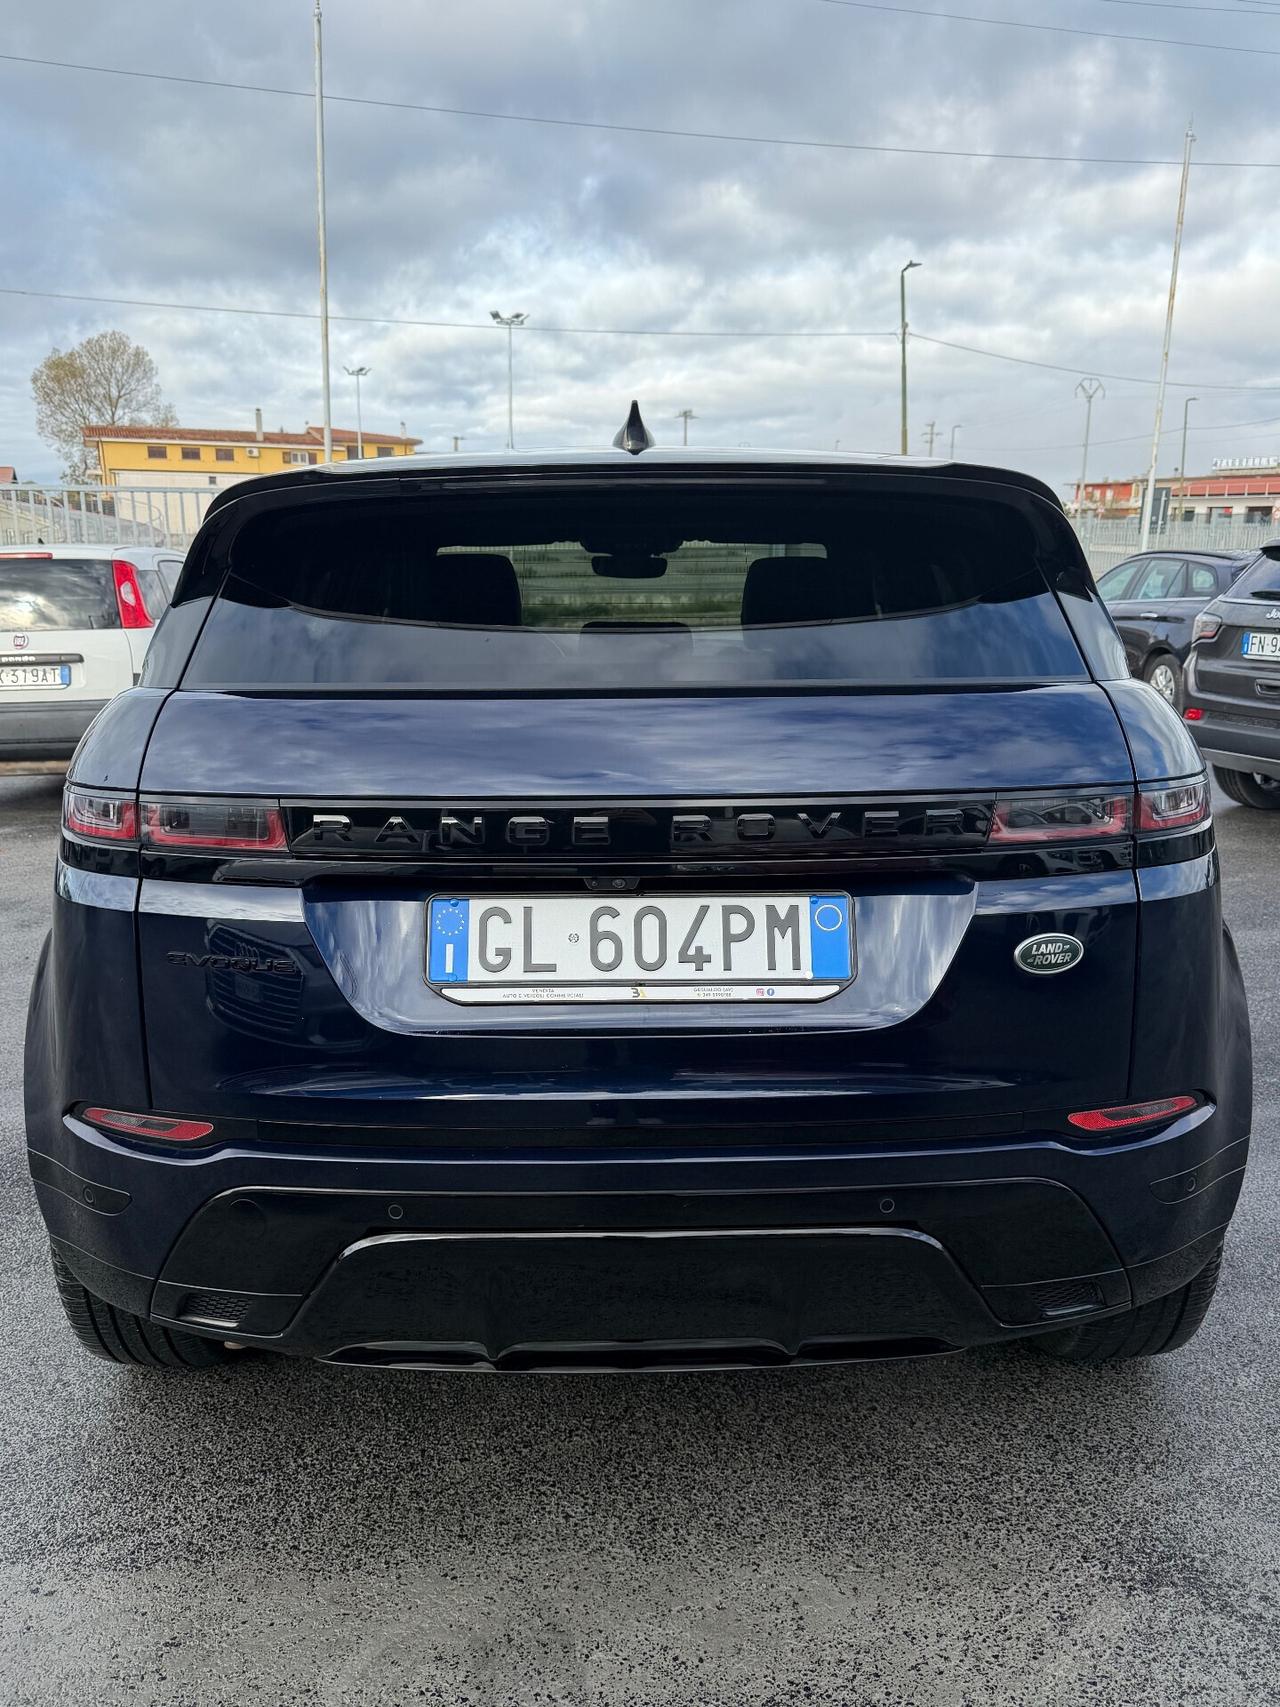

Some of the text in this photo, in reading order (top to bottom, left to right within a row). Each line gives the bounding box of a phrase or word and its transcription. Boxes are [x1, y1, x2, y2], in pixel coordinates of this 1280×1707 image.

[1265, 608, 1280, 619] Je
[1250, 635, 1280, 653] FN 9
[11, 668, 59, 684] 319AT
[312, 808, 966, 846] RANGE ROVER
[478, 904, 801, 973] GL 604PM
[1031, 942, 1063, 955] LAND
[1033, 952, 1072, 966] ROVER
